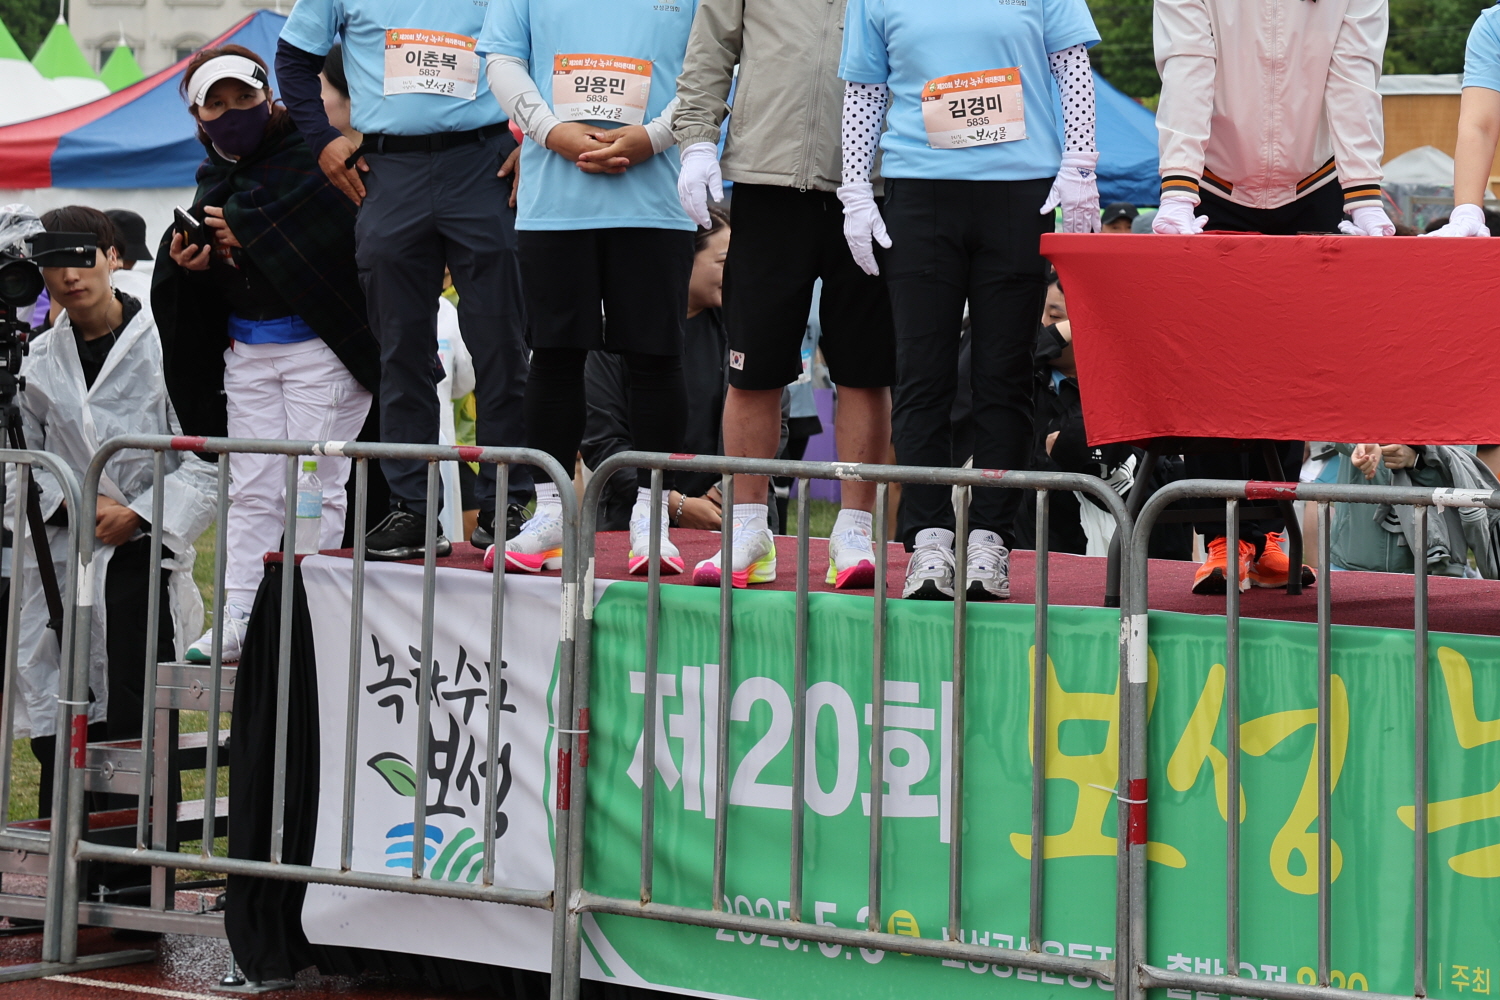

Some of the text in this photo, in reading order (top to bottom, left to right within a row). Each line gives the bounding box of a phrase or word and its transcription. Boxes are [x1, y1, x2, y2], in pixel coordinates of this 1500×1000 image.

[405, 50, 458, 70] 이춘복
[418, 68, 441, 77] 5837
[574, 76, 626, 95] 임용민
[586, 94, 608, 103] 5836
[948, 93, 1003, 119] 김경미
[966, 116, 990, 127] 5835
[425, 713, 513, 839] 보성
[626, 663, 955, 842] 제20회
[1009, 643, 1349, 894] 보성
[1451, 964, 1490, 995] 주최
